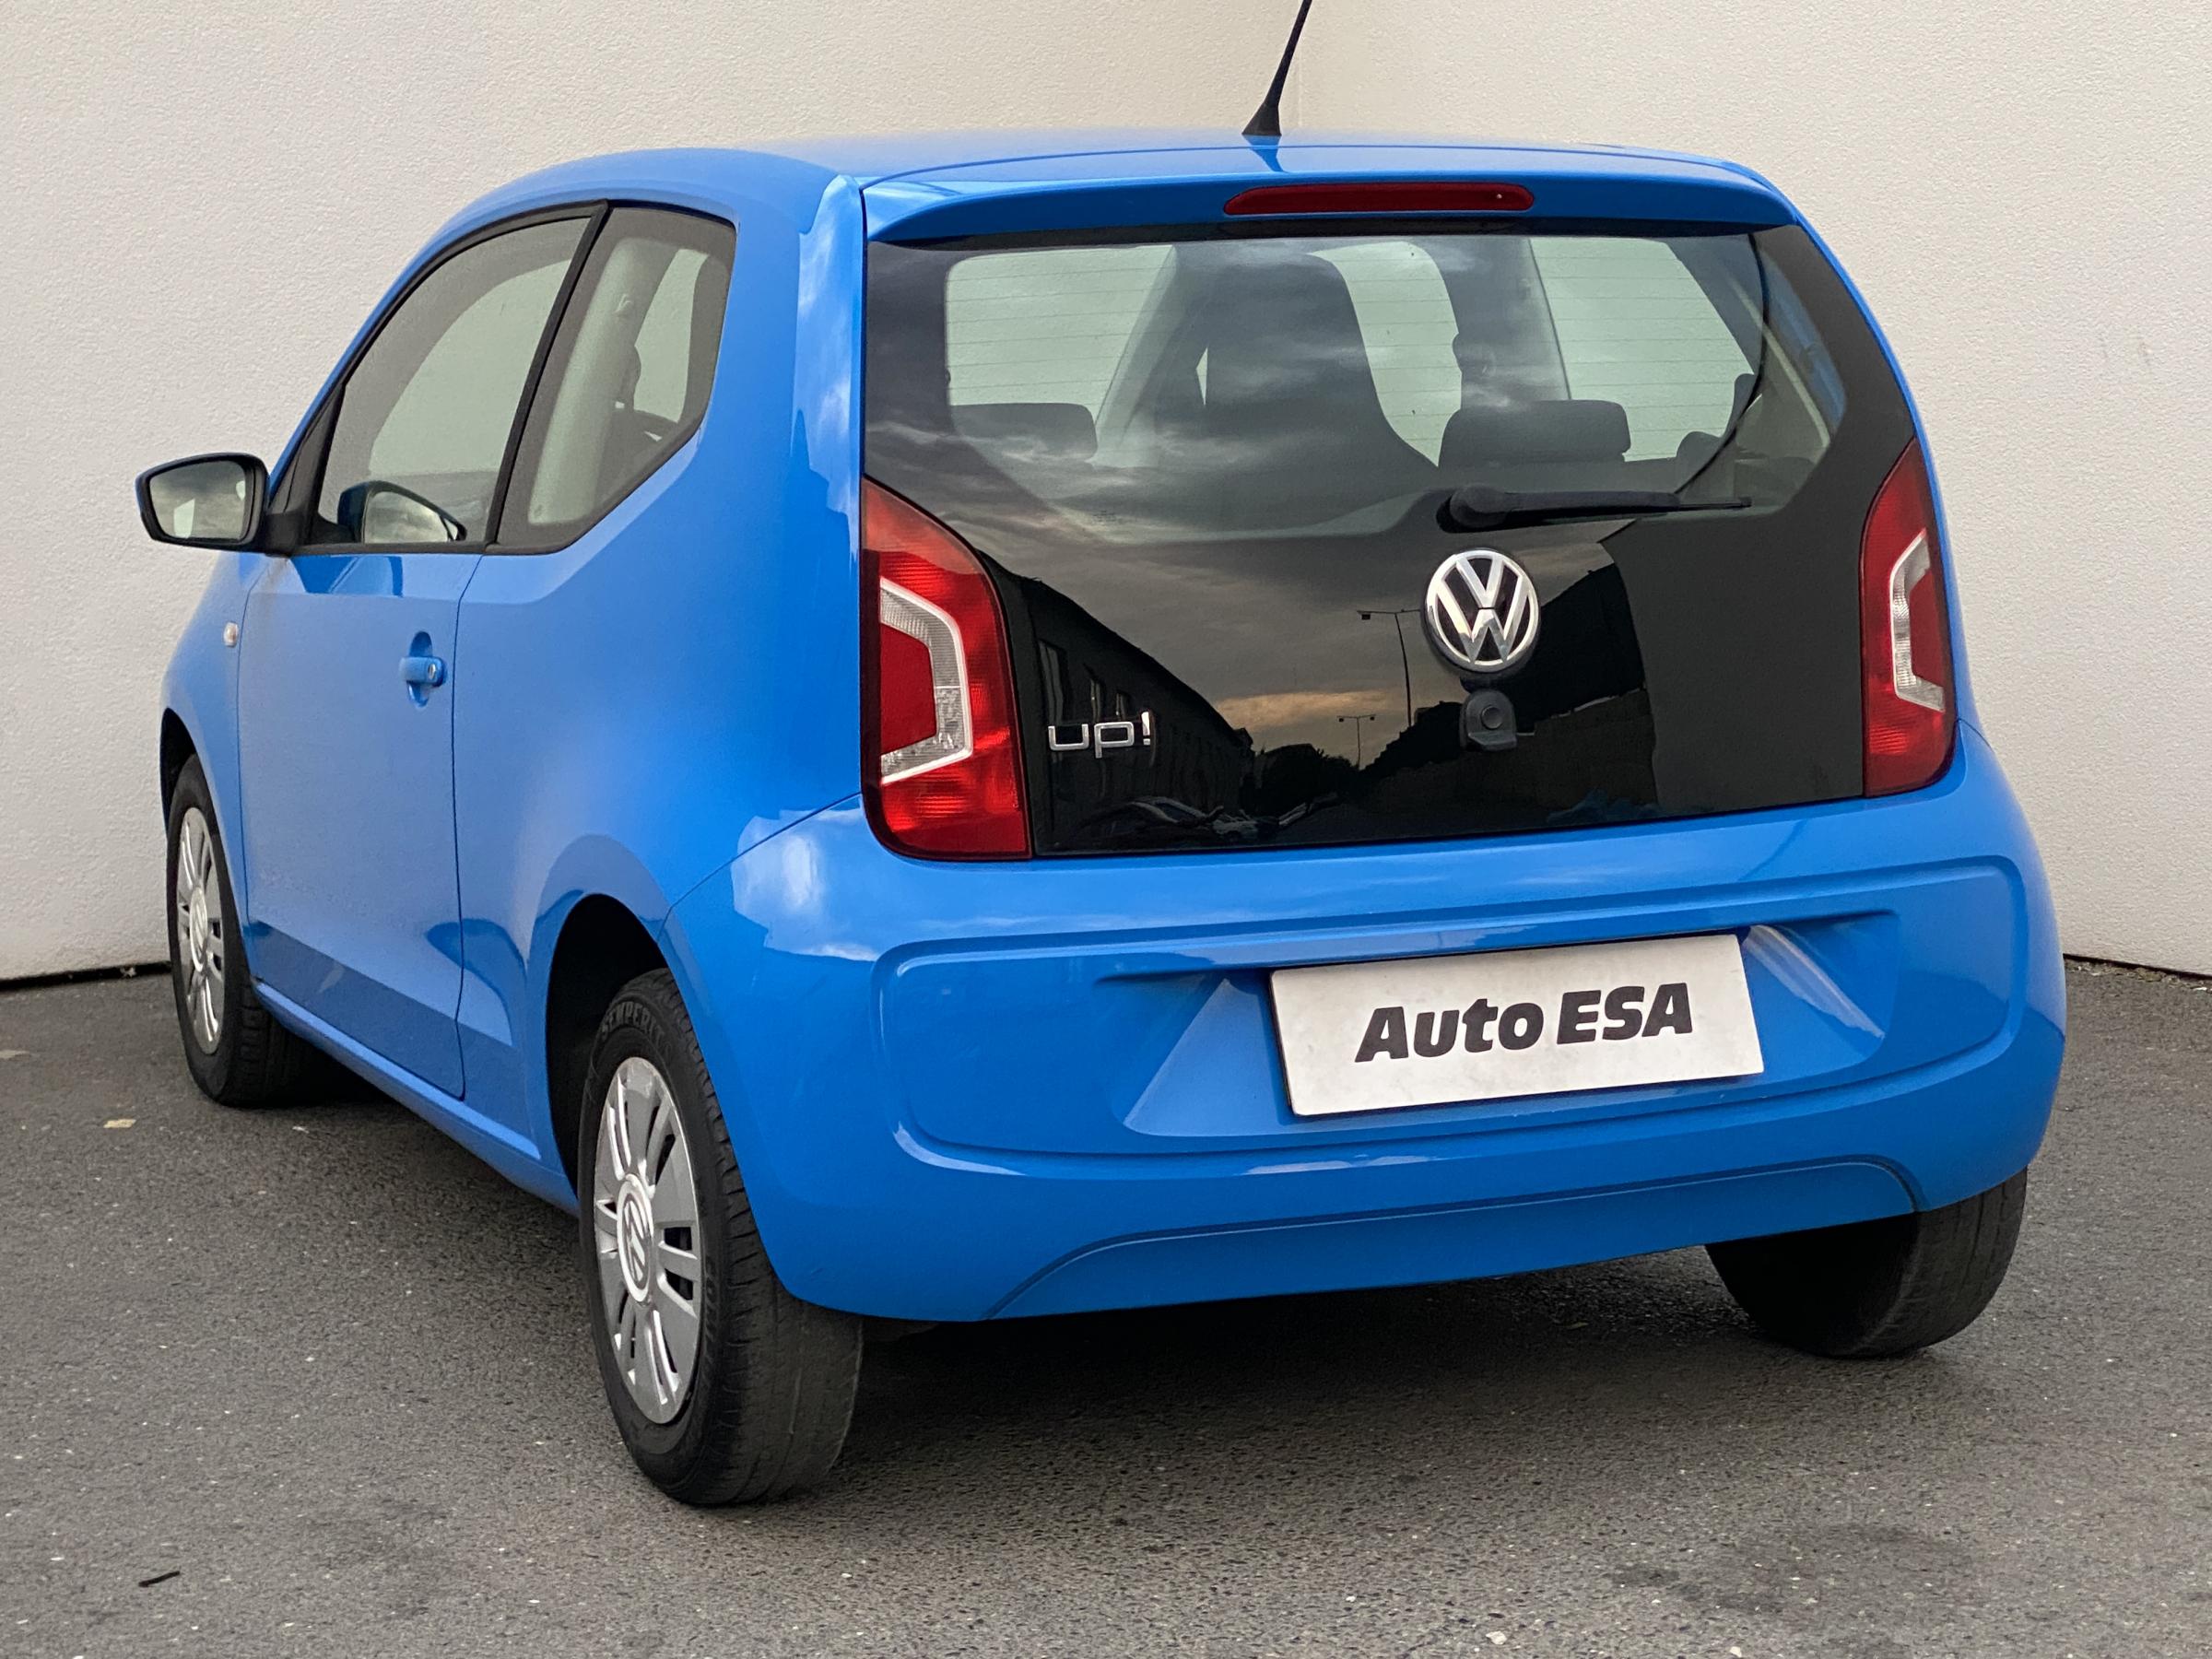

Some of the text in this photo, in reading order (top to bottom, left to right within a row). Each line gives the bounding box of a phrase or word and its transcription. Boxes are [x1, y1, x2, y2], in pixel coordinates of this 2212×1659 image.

[1048, 711, 1150, 759] up!
[1354, 982, 1693, 1063] Auto ESA
